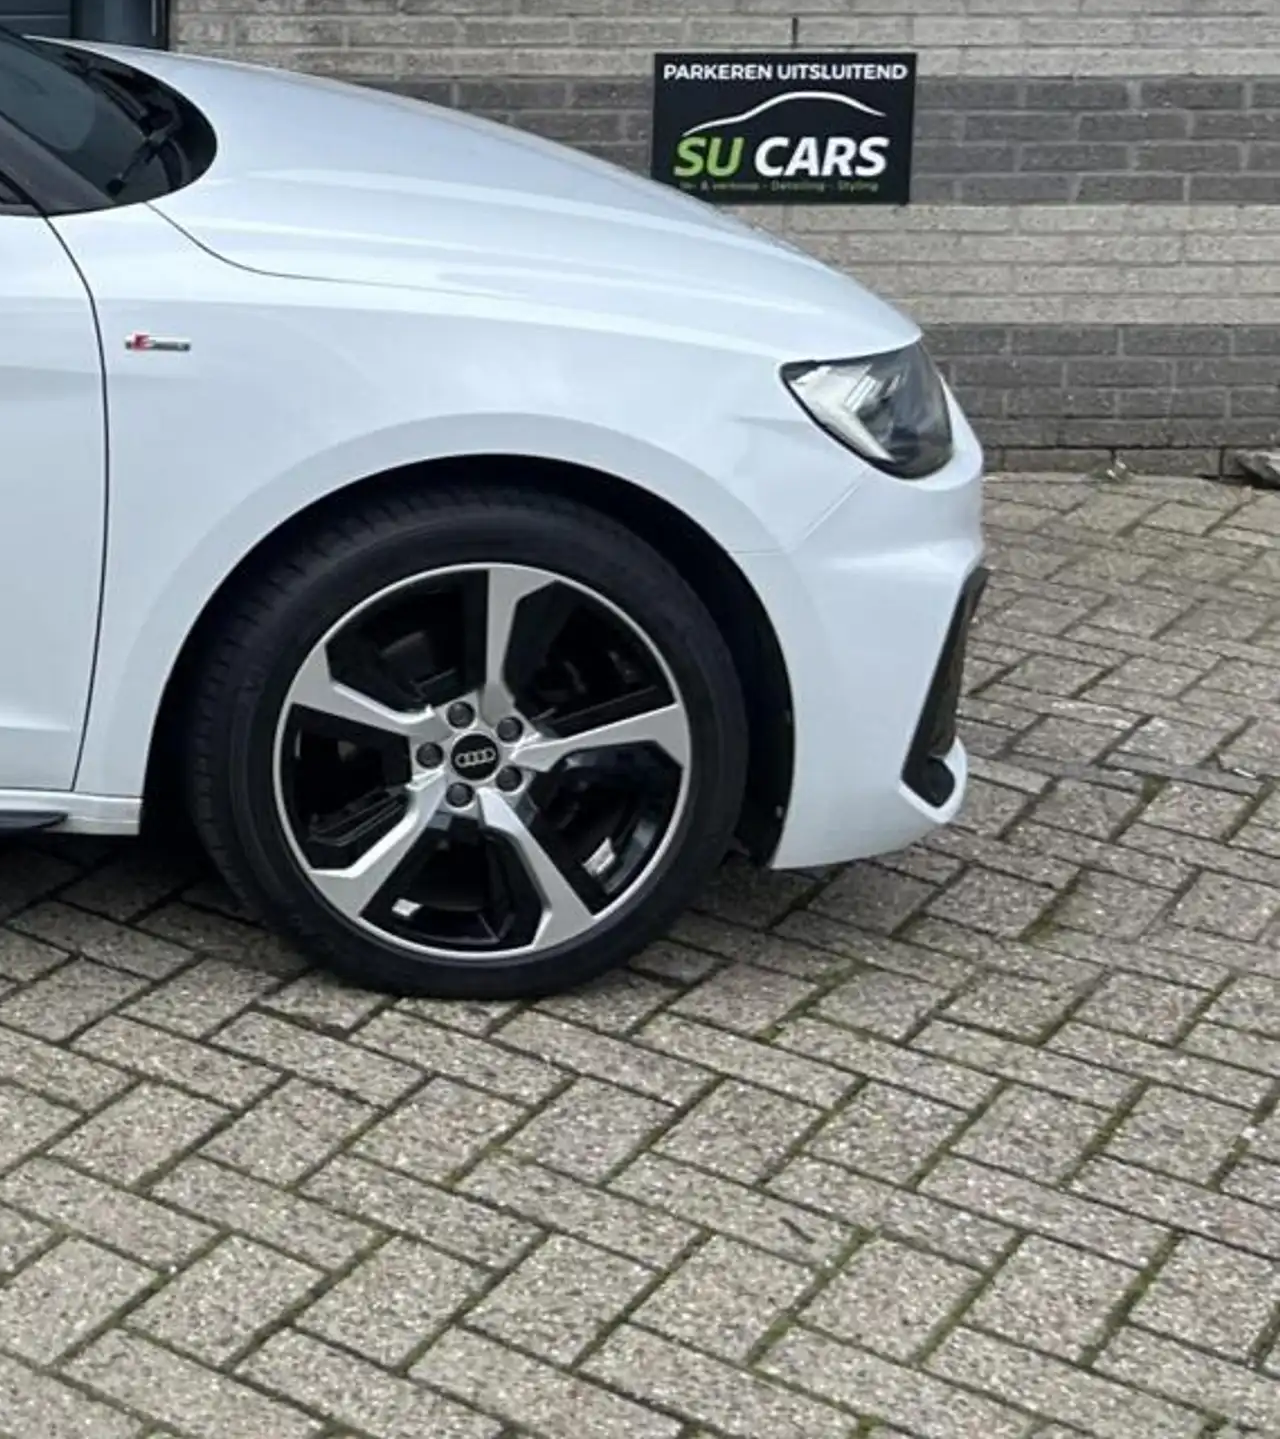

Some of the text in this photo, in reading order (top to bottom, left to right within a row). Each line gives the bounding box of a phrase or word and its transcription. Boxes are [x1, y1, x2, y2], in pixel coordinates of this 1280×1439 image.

[663, 63, 908, 80] PARKEREN UITSLUITEND
[673, 135, 889, 177] SU CARS
